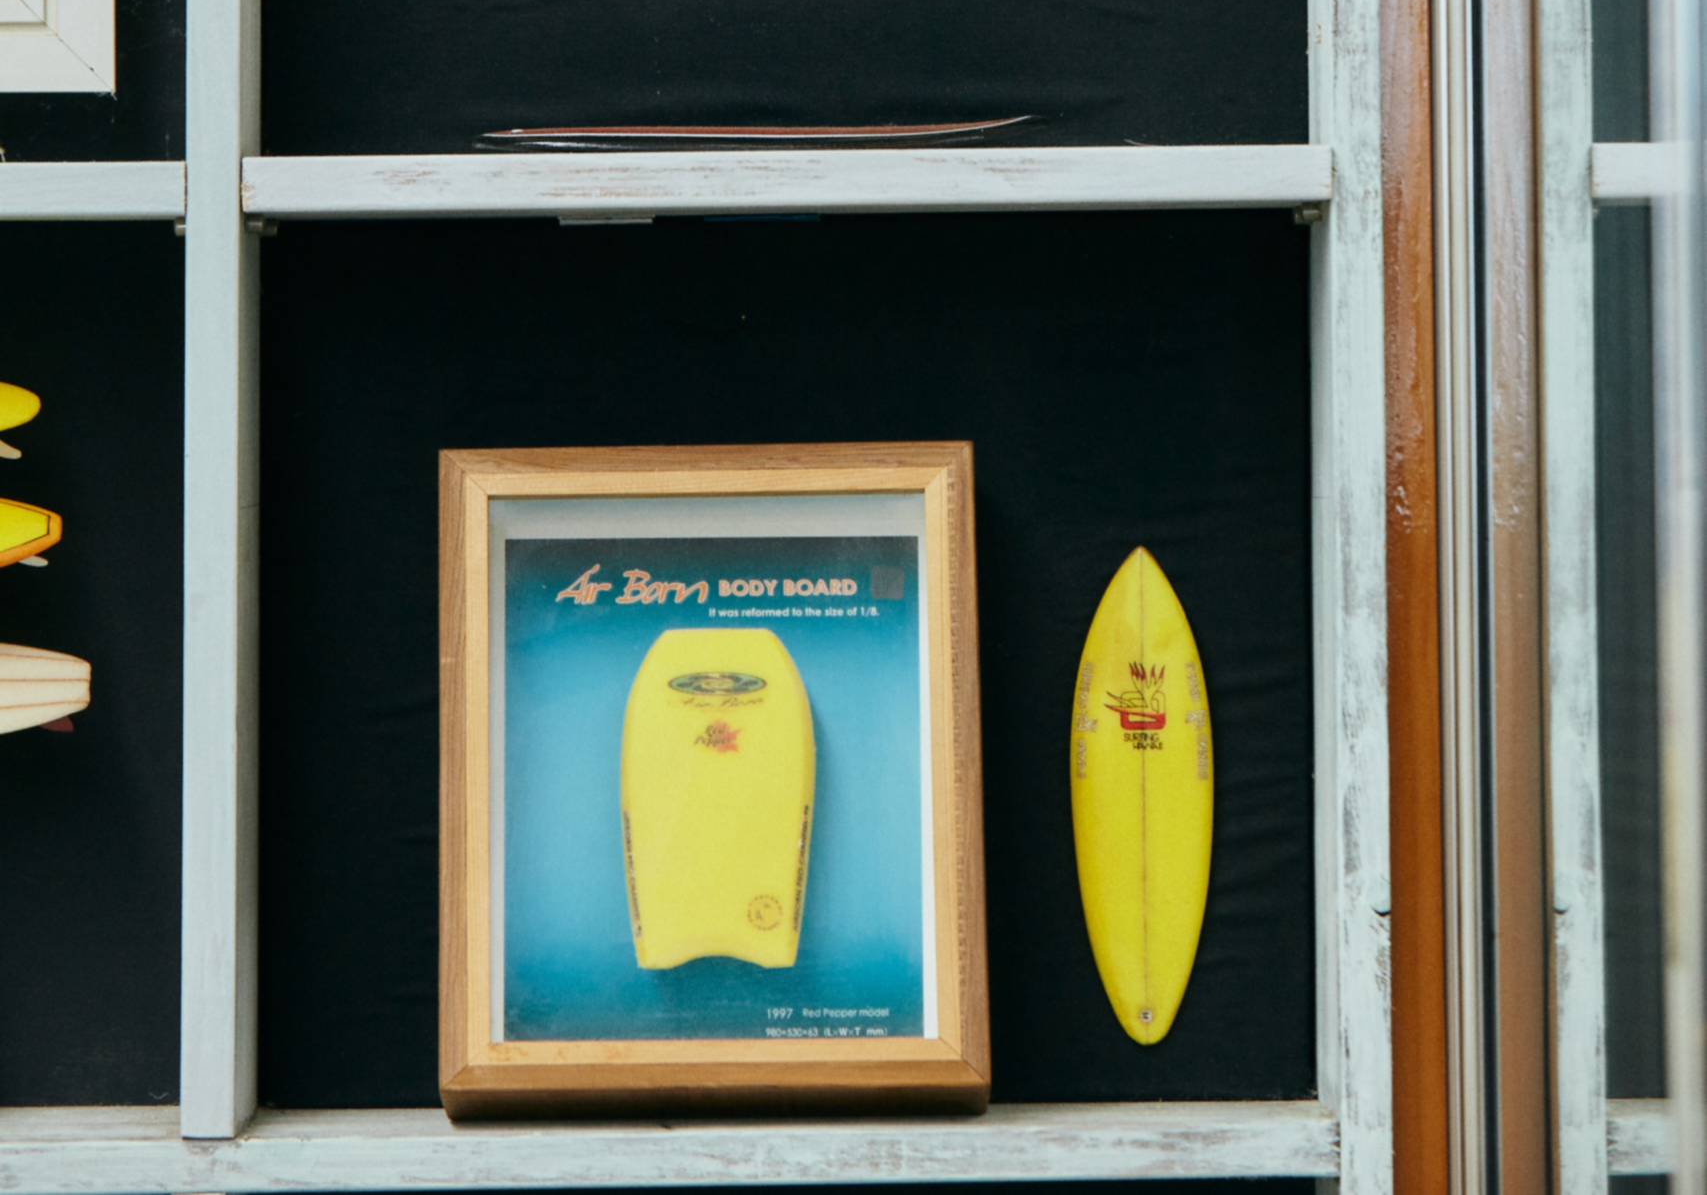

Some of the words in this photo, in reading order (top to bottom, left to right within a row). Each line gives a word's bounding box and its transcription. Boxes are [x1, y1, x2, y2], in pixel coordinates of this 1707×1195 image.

[555, 563, 612, 605] Air
[615, 568, 710, 604] Born
[718, 578, 777, 597] BODY
[783, 578, 857, 596] BOARD
[708, 607, 717, 618] It
[718, 609, 739, 618] was
[741, 607, 790, 618] reformed
[792, 607, 803, 617] to
[805, 607, 822, 617] the
[824, 607, 844, 617] size
[846, 607, 858, 617] of
[860, 606, 880, 618] 1/8.
[767, 1008, 793, 1020] 1997
[802, 1008, 821, 1018] Red
[823, 1008, 857, 1018] Pepper
[859, 1006, 889, 1017] model
